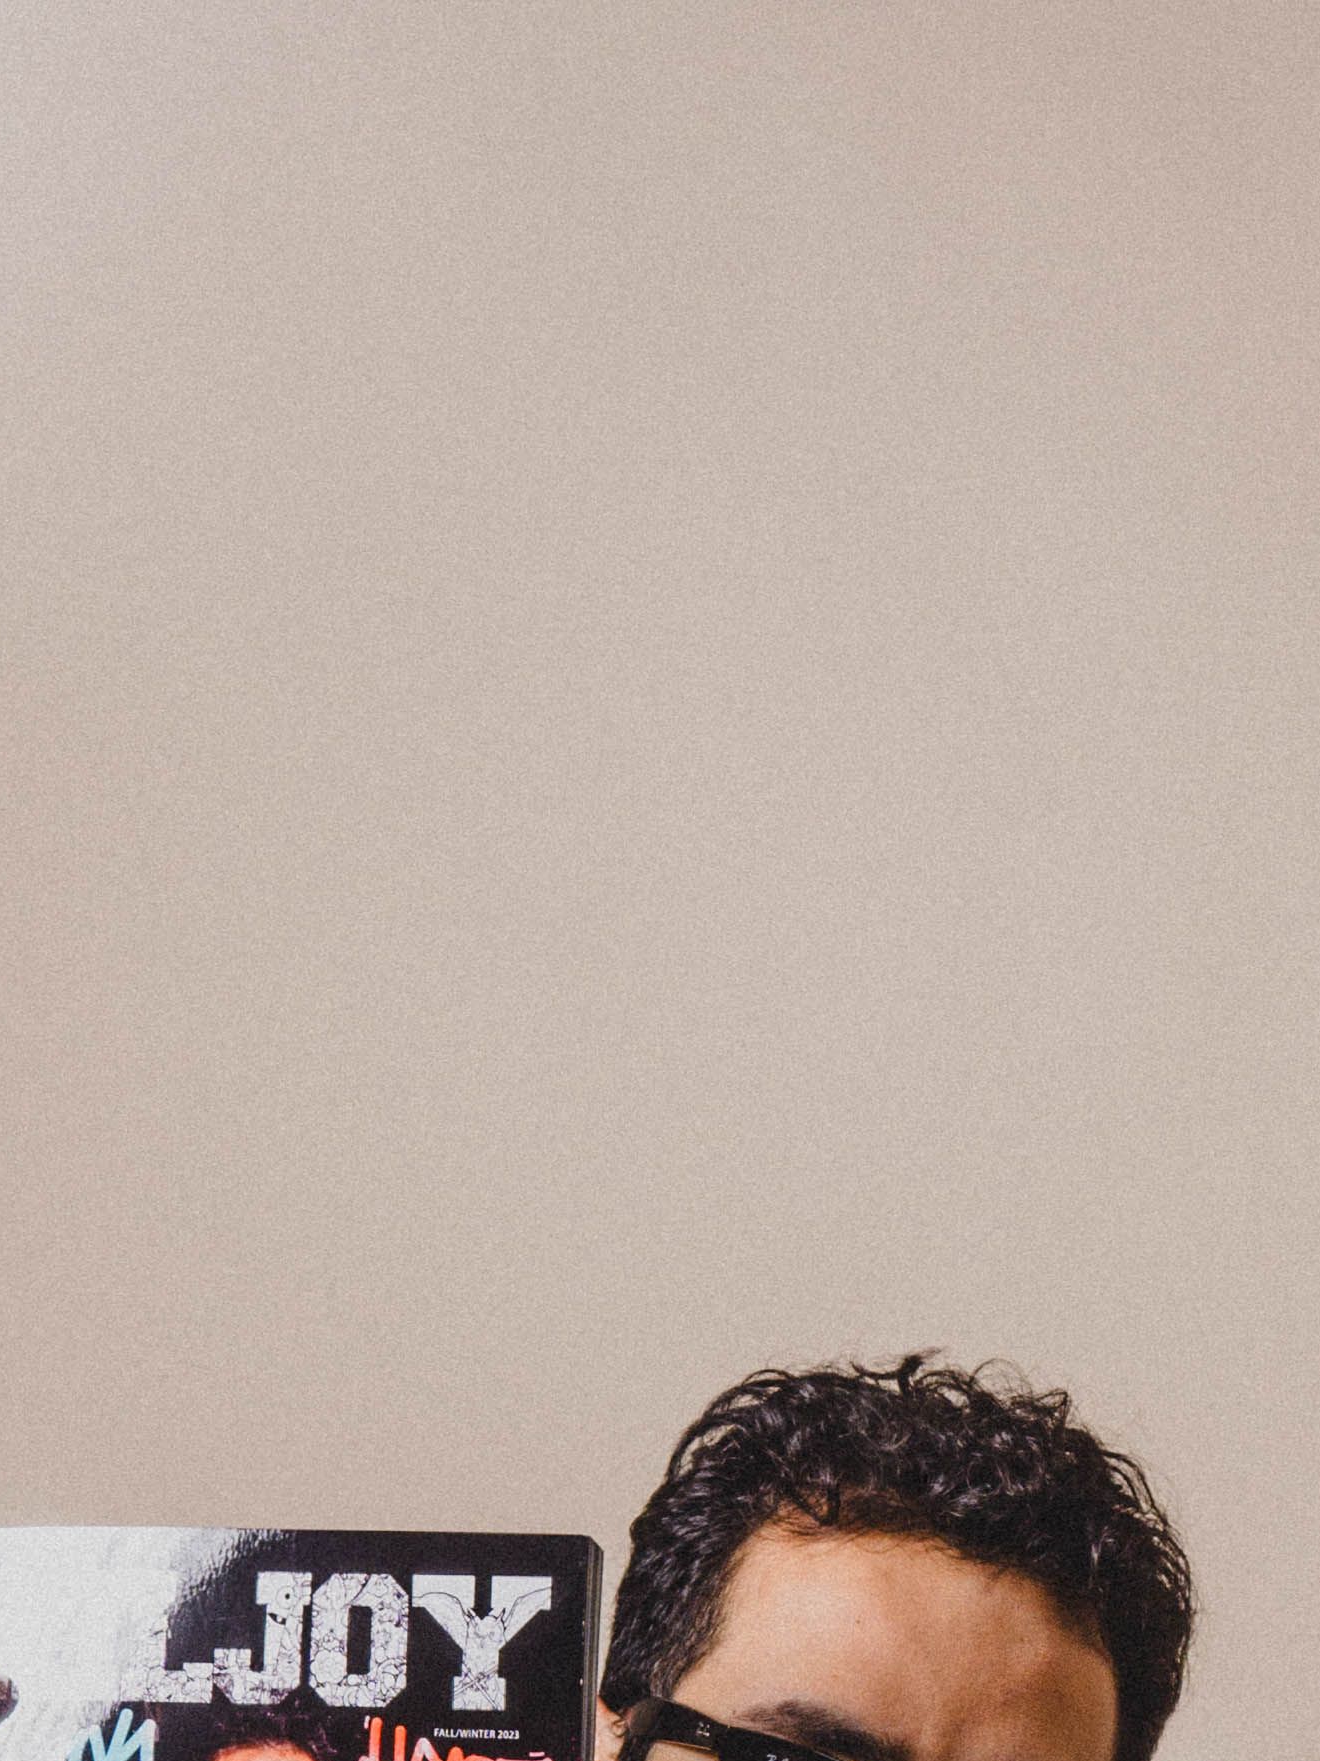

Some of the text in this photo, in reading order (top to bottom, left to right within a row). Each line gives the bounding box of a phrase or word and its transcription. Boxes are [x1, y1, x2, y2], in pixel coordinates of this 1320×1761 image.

[120, 1572, 552, 1712] LJOY
[433, 1727, 520, 1740] FALL/WINTER 2023
